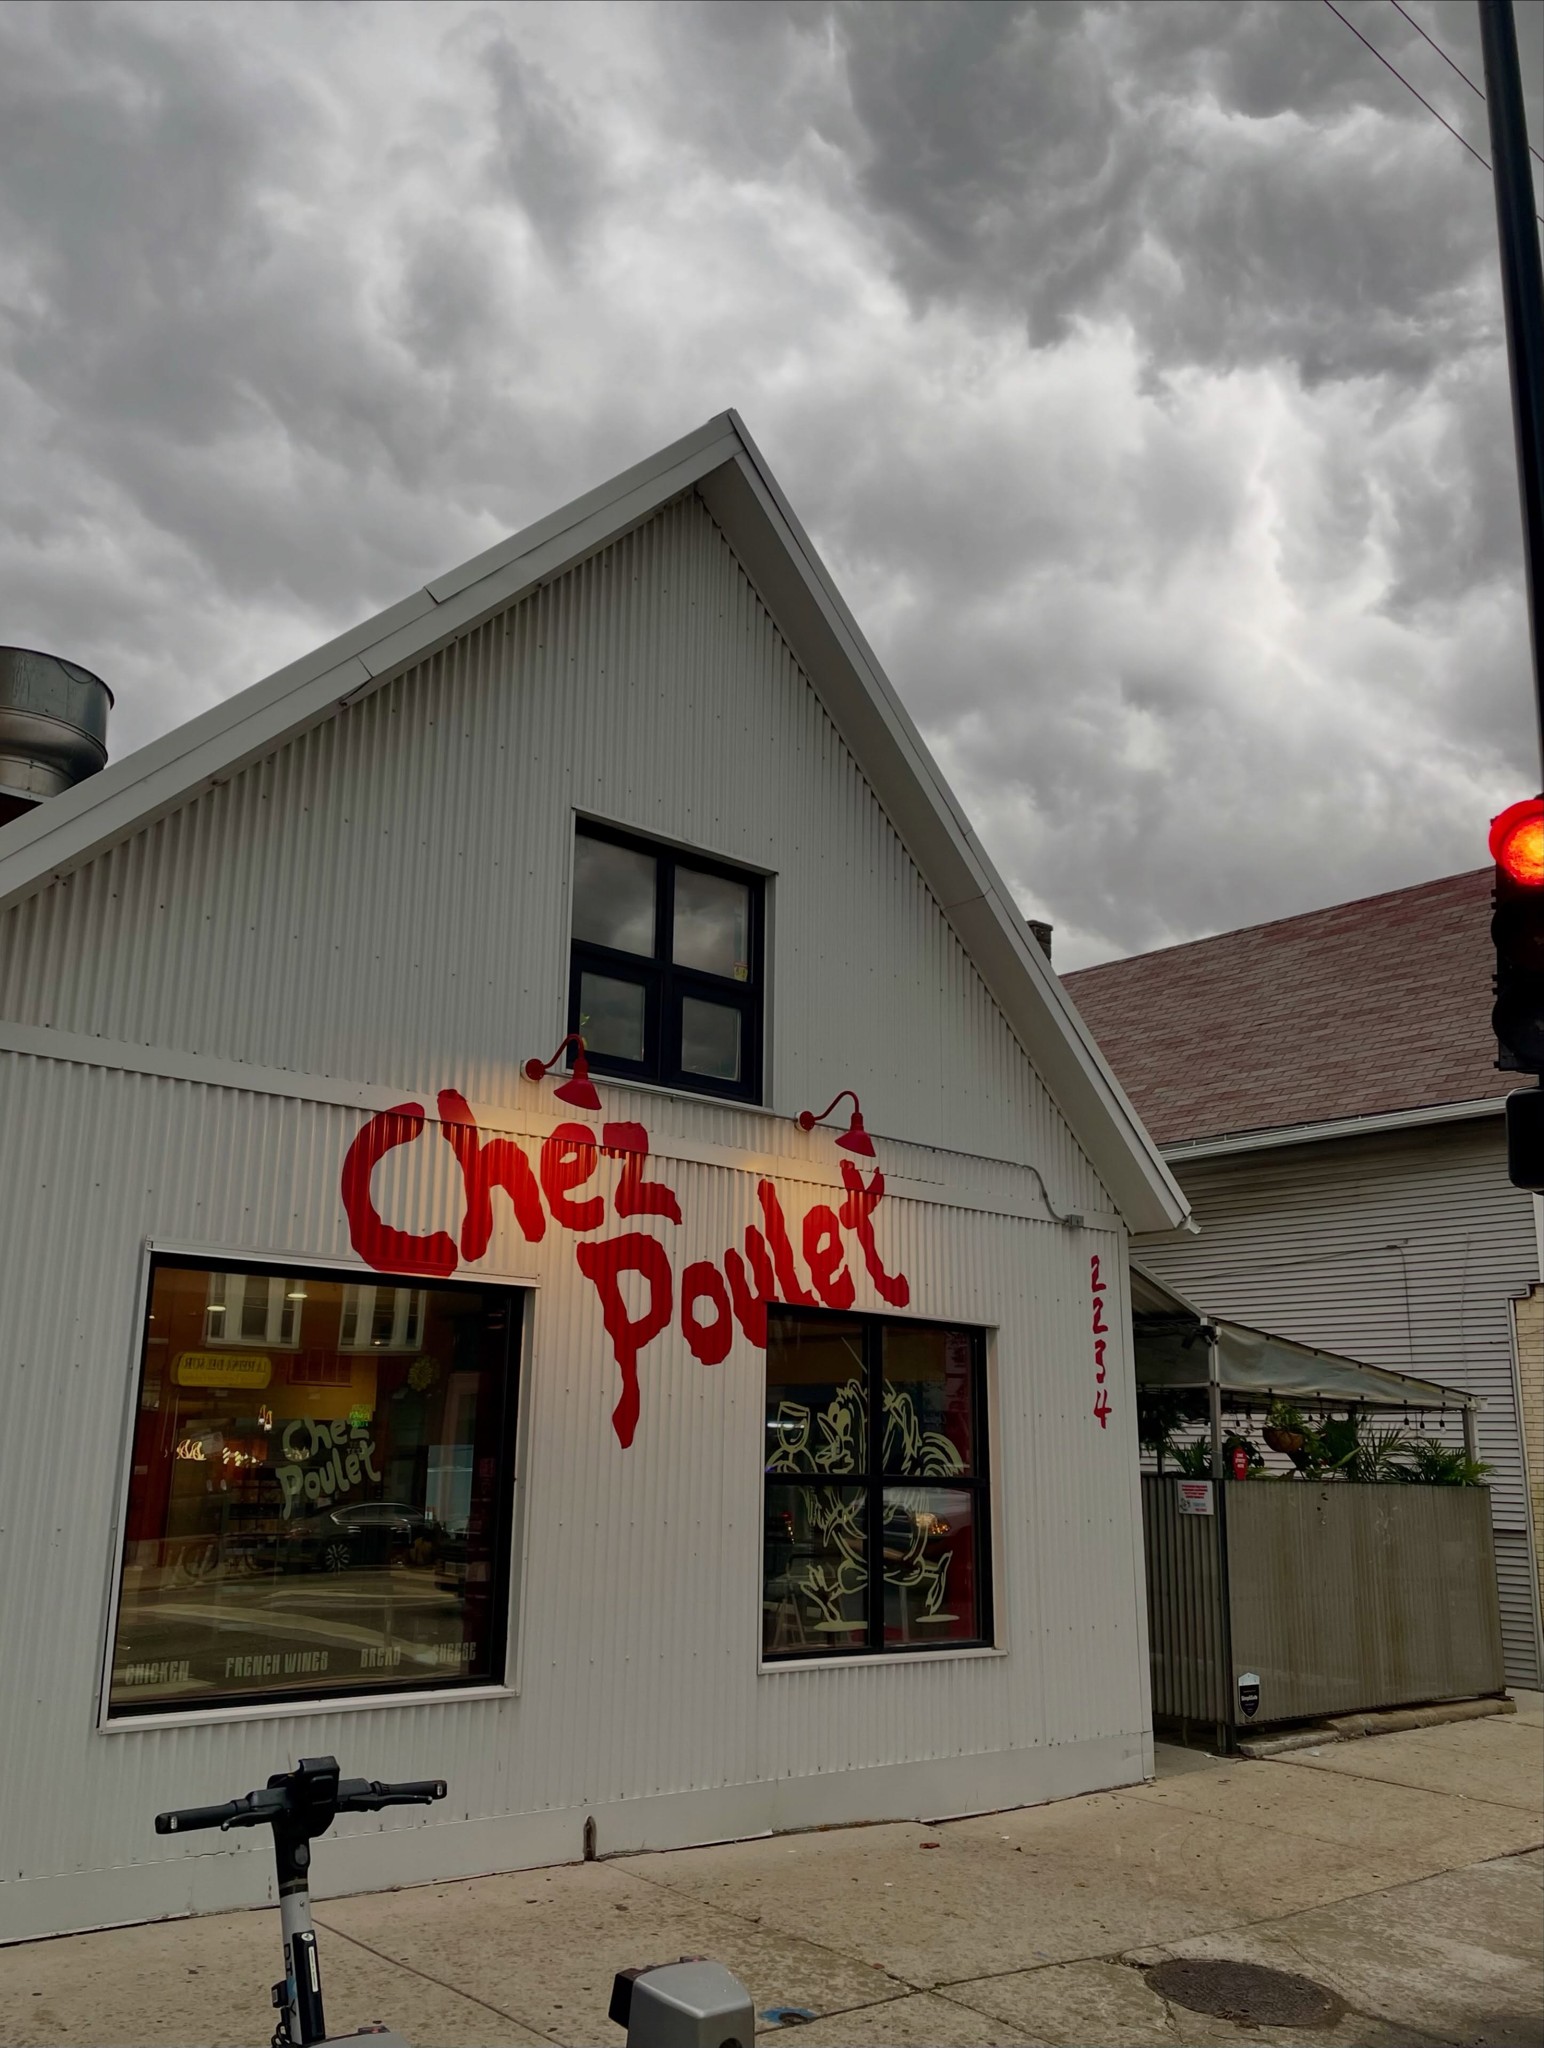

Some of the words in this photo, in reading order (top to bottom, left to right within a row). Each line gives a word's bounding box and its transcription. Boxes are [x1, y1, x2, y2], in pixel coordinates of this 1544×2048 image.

[341, 1088, 682, 1277] Chez
[576, 1159, 910, 1449] Poulet
[225, 1653, 281, 1679] FRENCH
[284, 1651, 329, 1674] WINES
[360, 1646, 401, 1668] BREAD
